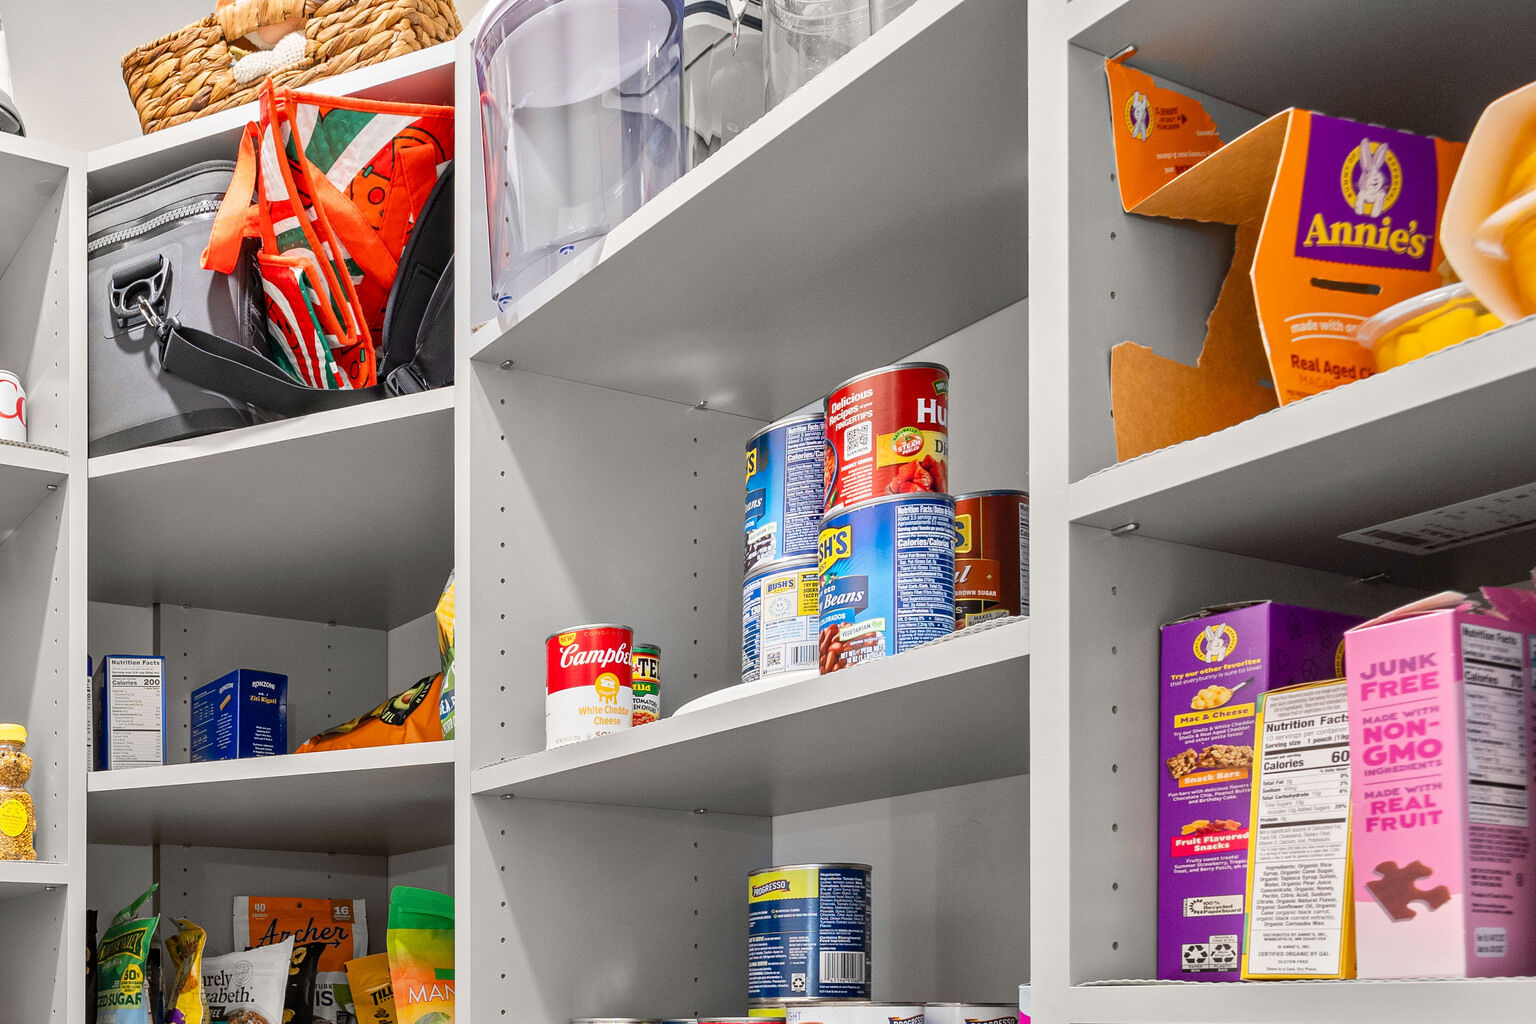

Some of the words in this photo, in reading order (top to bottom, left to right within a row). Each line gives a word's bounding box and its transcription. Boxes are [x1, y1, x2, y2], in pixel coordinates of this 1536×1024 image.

[1303, 213, 1427, 259] Annie's
[1291, 320, 1317, 333] made
[1320, 320, 1343, 331] with
[1291, 354, 1320, 373] Real
[1323, 358, 1356, 379] Aged
[831, 389, 873, 414] Delicious
[829, 404, 859, 427] Recipes
[835, 410, 873, 432] FINGERTIPS
[898, 439, 922, 453] STEAM
[767, 579, 794, 593] BUSH'S
[977, 589, 997, 597] SUGAR
[824, 590, 865, 610] Beans
[841, 623, 871, 637] VEGETARIAN
[1462, 628, 1495, 642] Nutrition
[1496, 633, 1517, 646] Facts
[1185, 670, 1198, 678] our
[1199, 666, 1222, 675] other
[1223, 658, 1262, 671] favorites
[1359, 651, 1438, 681] JUNK
[143, 678, 160, 686] 200
[251, 681, 276, 690] RONZONI
[1360, 670, 1440, 702] FREE
[1465, 671, 1498, 685] Calories
[578, 705, 603, 715] White
[1180, 715, 1200, 724] Mac
[1213, 707, 1249, 719] Cheese
[1362, 712, 1399, 726] MADE
[1402, 705, 1440, 718] WITH
[593, 716, 621, 725] Cheese
[1265, 719, 1315, 733] Nutrition
[1363, 718, 1441, 745] NON-
[1264, 741, 1288, 750] Serving
[1363, 738, 1443, 767] GMO
[1264, 758, 1304, 772] Calories
[1331, 751, 1349, 763] 60
[1364, 760, 1443, 777] INGREDIENTS
[1184, 774, 1214, 784] Snack
[1216, 770, 1241, 780] Bars
[1364, 787, 1401, 800] MADE
[1405, 782, 1443, 794] WITH
[1370, 794, 1437, 816] REAL
[1366, 810, 1444, 833] FRUIT
[1175, 837, 1202, 847] Fruit
[1203, 832, 1249, 843] Flavored
[1193, 842, 1230, 852] Snacks
[753, 880, 786, 896] PROGRESSO
[333, 906, 349, 915] 16
[258, 917, 349, 947] Archer
